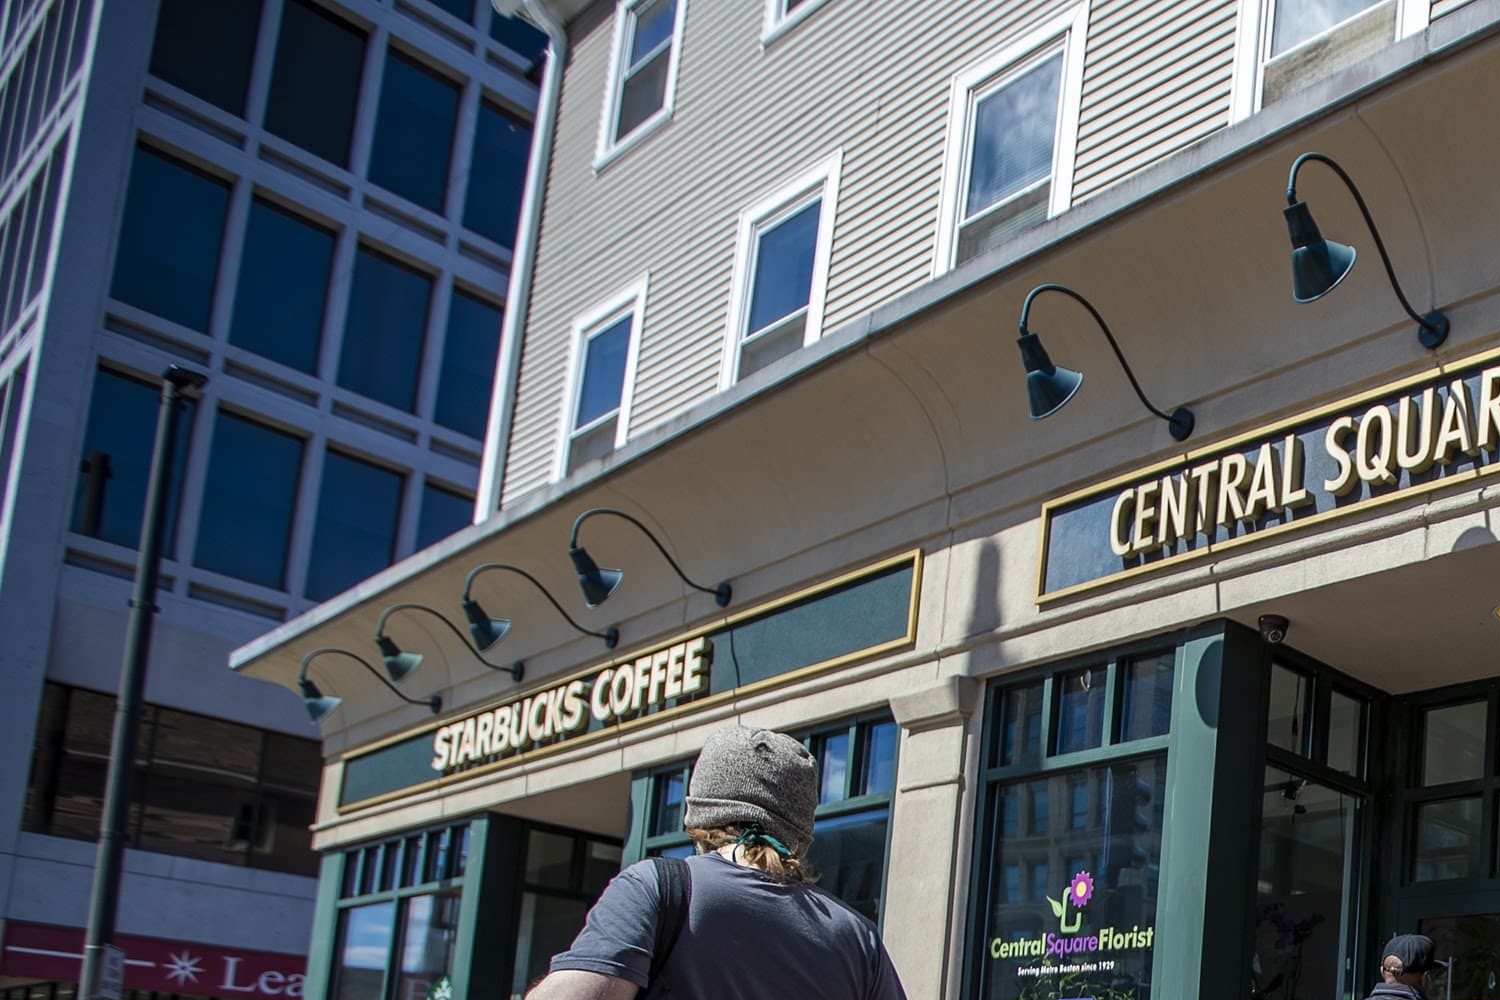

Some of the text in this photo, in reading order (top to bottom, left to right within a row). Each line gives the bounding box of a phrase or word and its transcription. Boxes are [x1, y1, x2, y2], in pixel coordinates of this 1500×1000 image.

[1110, 434, 1312, 557] CENTRAL
[431, 636, 711, 771] STARBUCKS COFFEE
[990, 925, 1153, 960] CentralSquareFlorist
[1017, 960, 1115, 977] Serving Metro Boston since 1929
